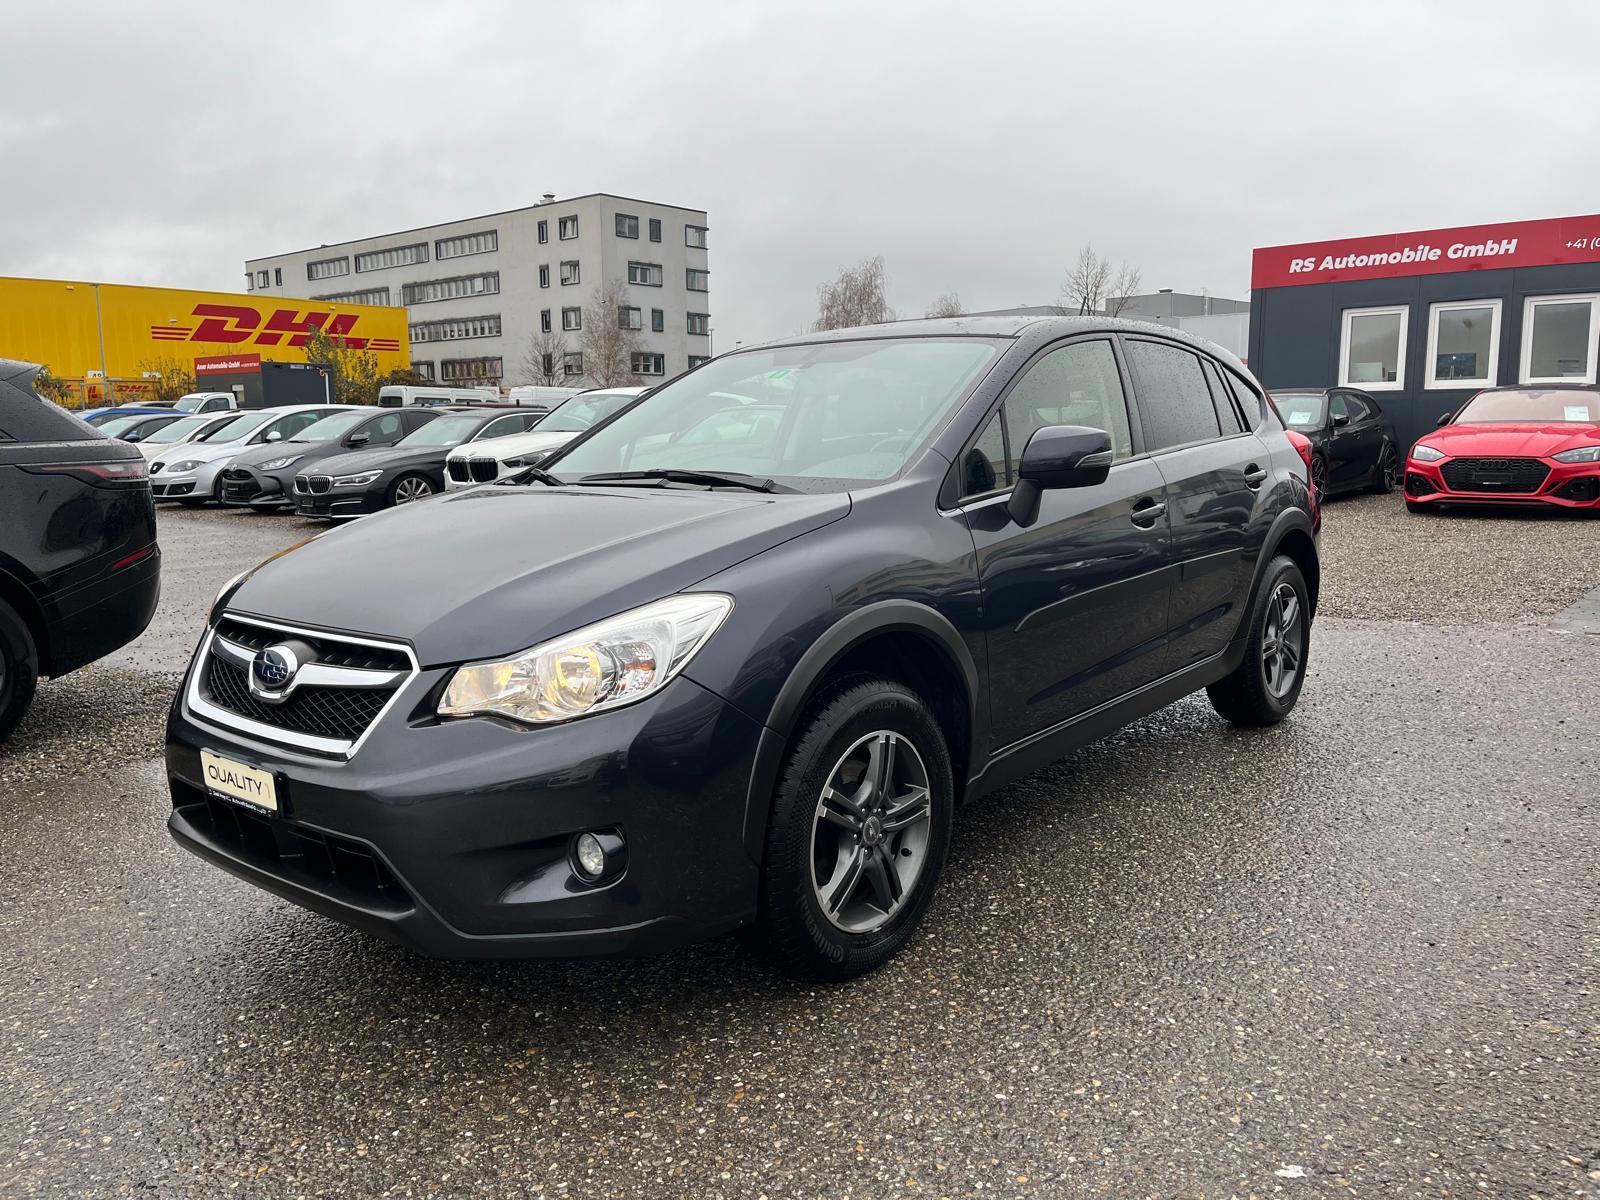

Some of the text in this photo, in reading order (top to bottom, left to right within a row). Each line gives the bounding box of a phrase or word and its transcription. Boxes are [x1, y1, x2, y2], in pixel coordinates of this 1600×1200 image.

[1289, 257, 1316, 273] RS
[1318, 244, 1442, 271] Automobile
[1447, 238, 1518, 259] GmbH
[1565, 238, 1588, 249] +41
[190, 303, 370, 350] DHL
[207, 361, 228, 370] Automobile
[228, 361, 241, 369] GmbH
[115, 384, 153, 393] DHL
[208, 764, 262, 796] QUALITY
